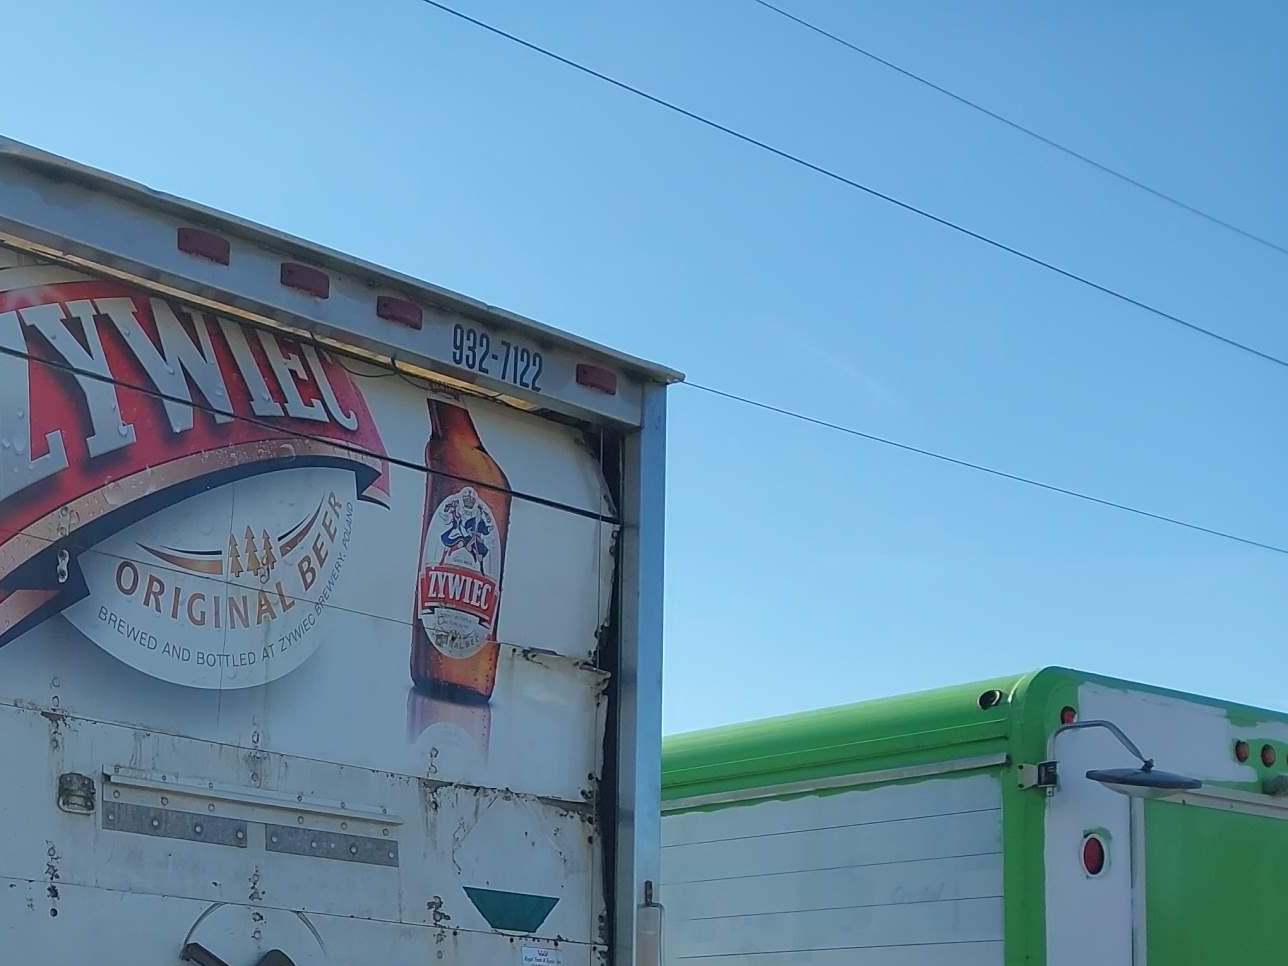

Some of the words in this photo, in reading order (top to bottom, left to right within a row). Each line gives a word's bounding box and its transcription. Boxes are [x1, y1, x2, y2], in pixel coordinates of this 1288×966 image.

[452, 323, 543, 392] 932-7122
[98, 605, 158, 650] BREWED
[162, 641, 192, 663] AND
[196, 651, 257, 668] BOTTLED
[262, 643, 275, 661] AT
[341, 501, 354, 551] POLAND
[116, 560, 296, 630] ORIGINAL
[297, 491, 343, 592] BEER
